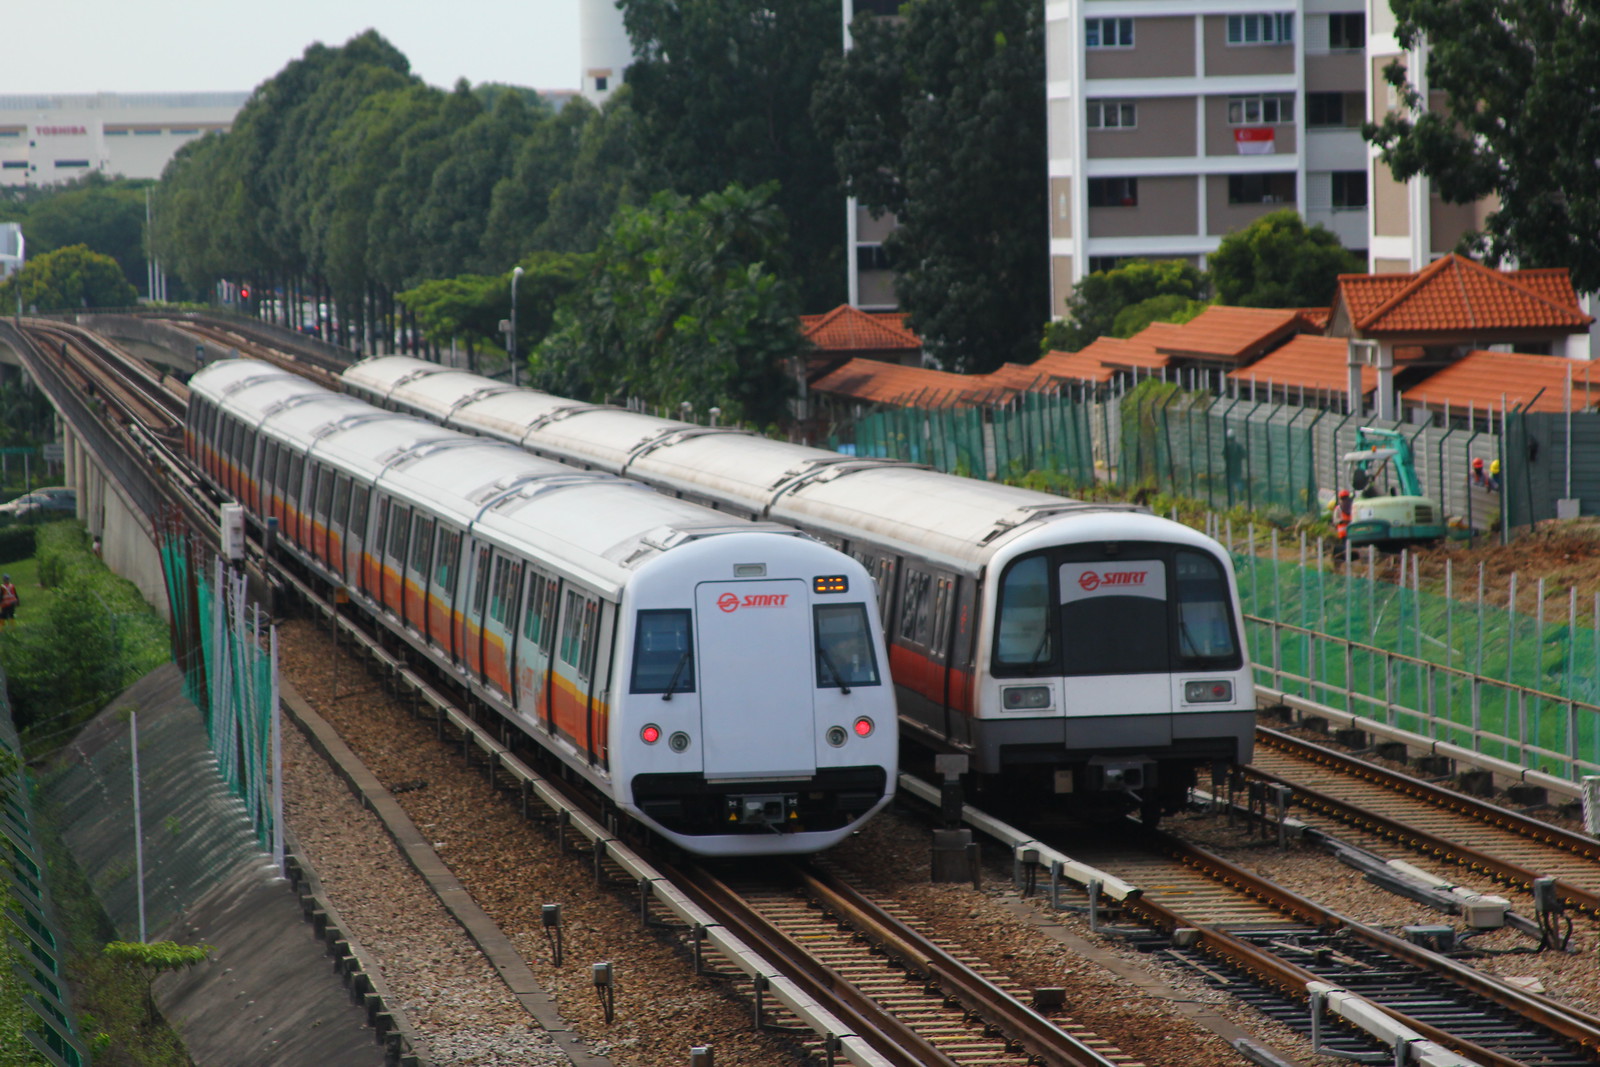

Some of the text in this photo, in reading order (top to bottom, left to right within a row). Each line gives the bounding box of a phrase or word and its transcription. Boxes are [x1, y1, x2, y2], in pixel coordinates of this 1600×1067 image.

[36, 125, 86, 135] TOSHIBA
[1101, 571, 1147, 585] SMRT
[741, 594, 789, 607] SMRT
